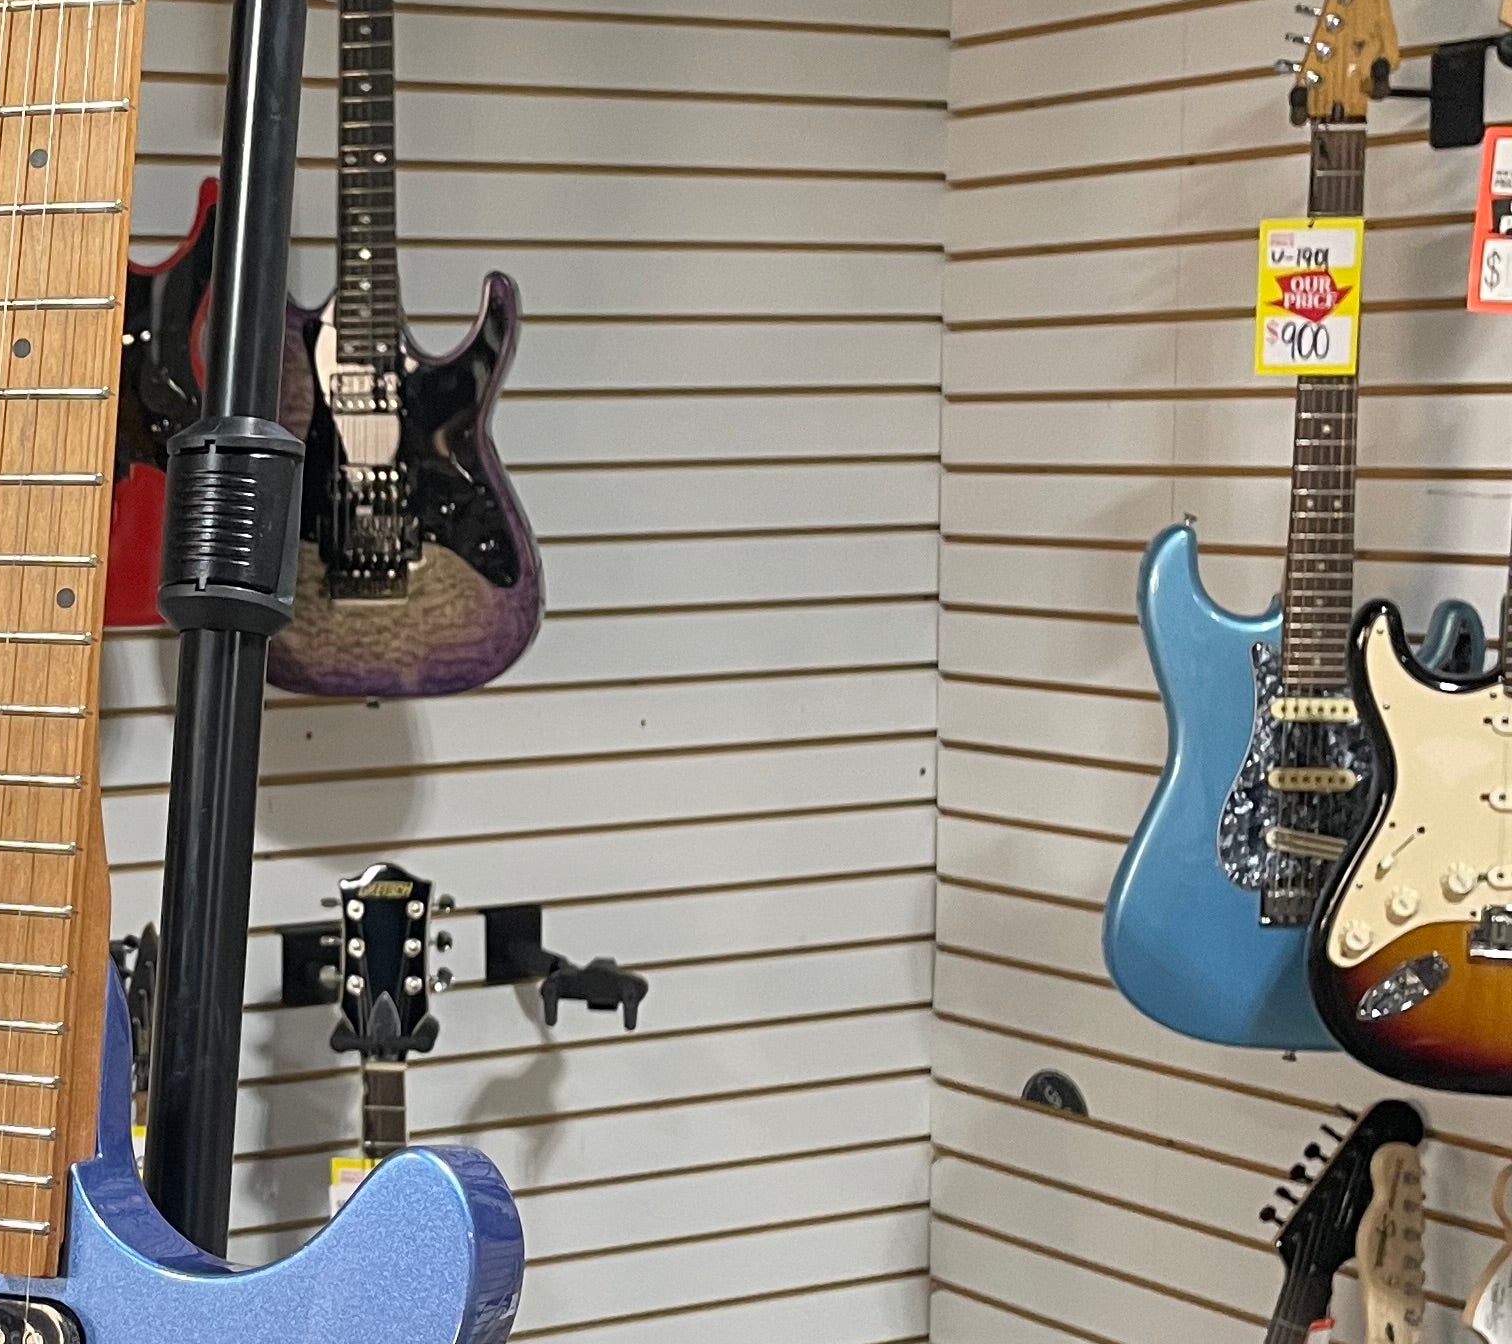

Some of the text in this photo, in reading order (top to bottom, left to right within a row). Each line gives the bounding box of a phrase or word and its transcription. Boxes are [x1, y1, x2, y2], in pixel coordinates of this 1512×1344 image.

[1290, 275, 1331, 293] OUR
[1284, 291, 1338, 309] PRICE
[1266, 320, 1330, 362] $900
